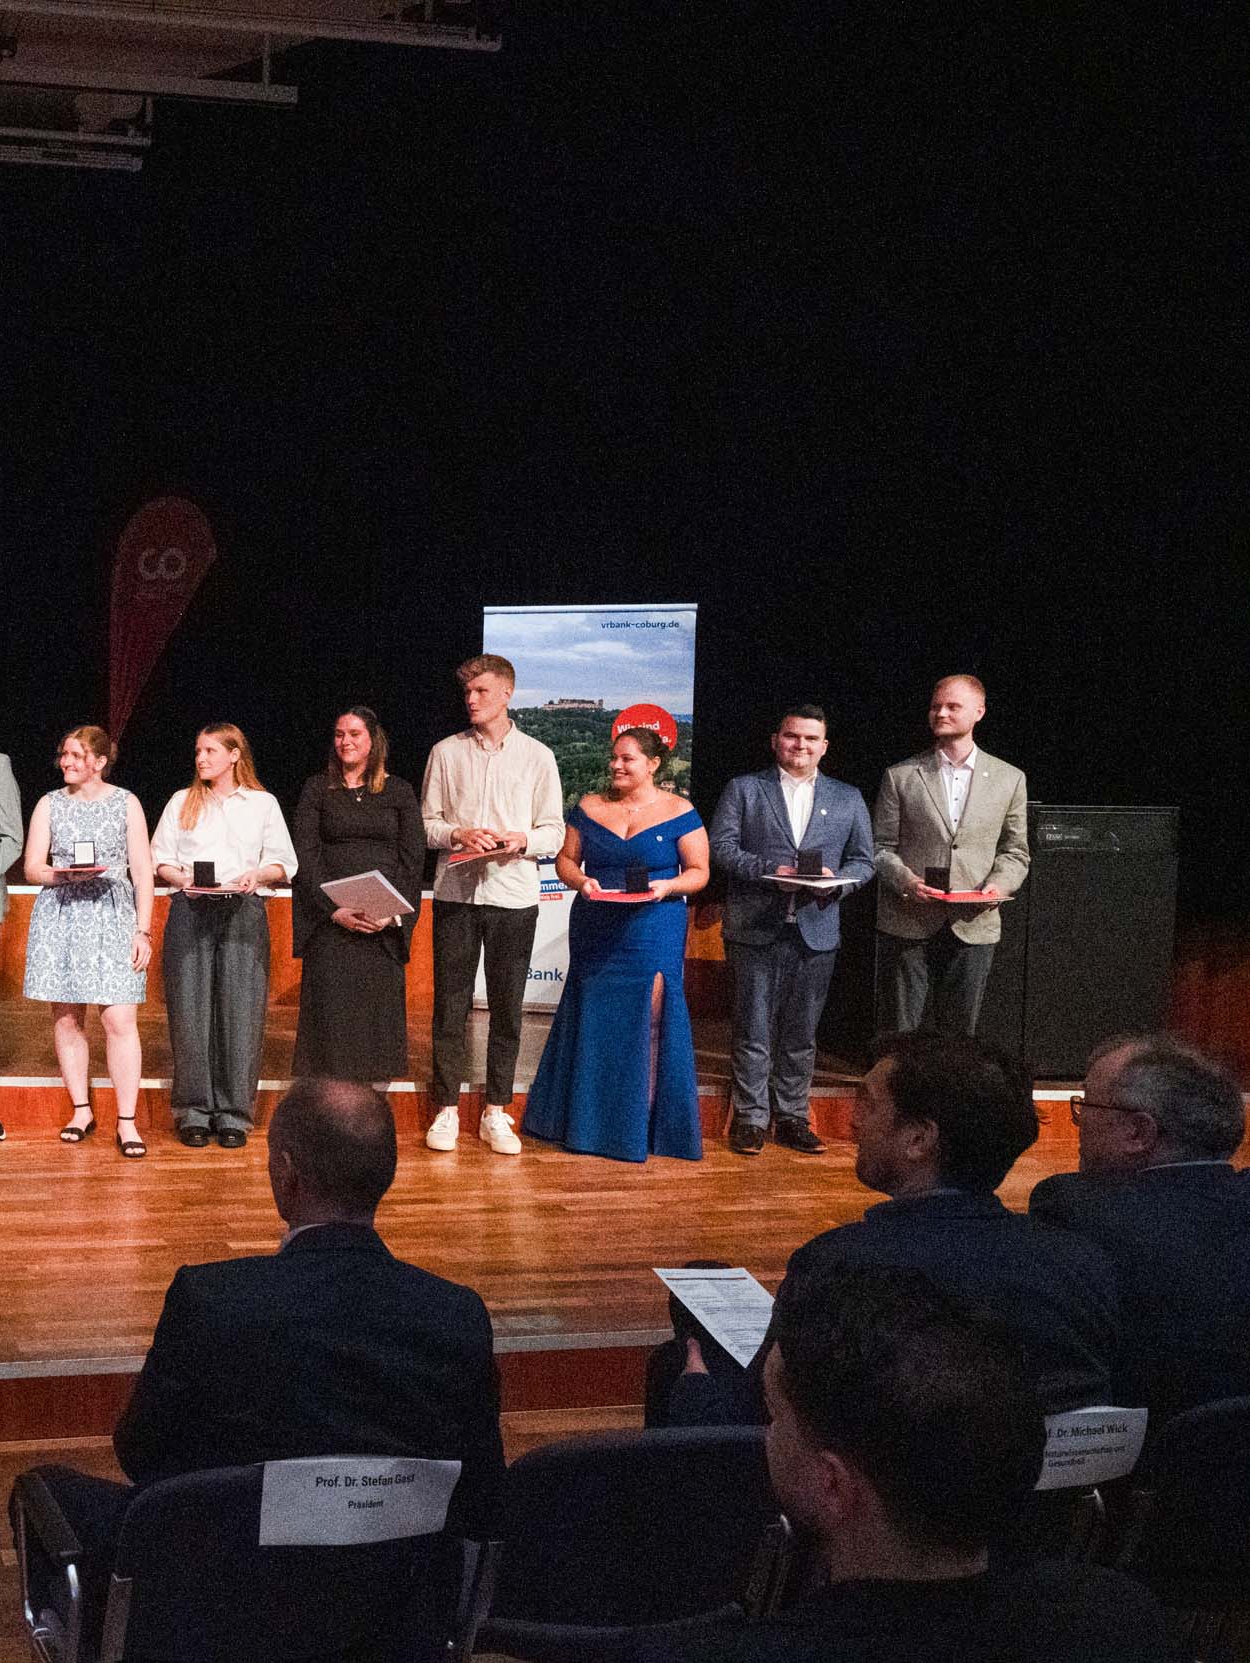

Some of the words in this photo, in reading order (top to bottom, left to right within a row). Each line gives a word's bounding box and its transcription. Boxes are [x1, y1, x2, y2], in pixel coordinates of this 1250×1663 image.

[601, 620, 680, 630] vrbank-coburg.de
[1071, 1424, 1105, 1437] Michael
[1107, 1423, 1128, 1433] Wick
[316, 1475, 342, 1488] Prof.
[345, 1475, 358, 1487] Dr.
[361, 1474, 393, 1487] Stefan
